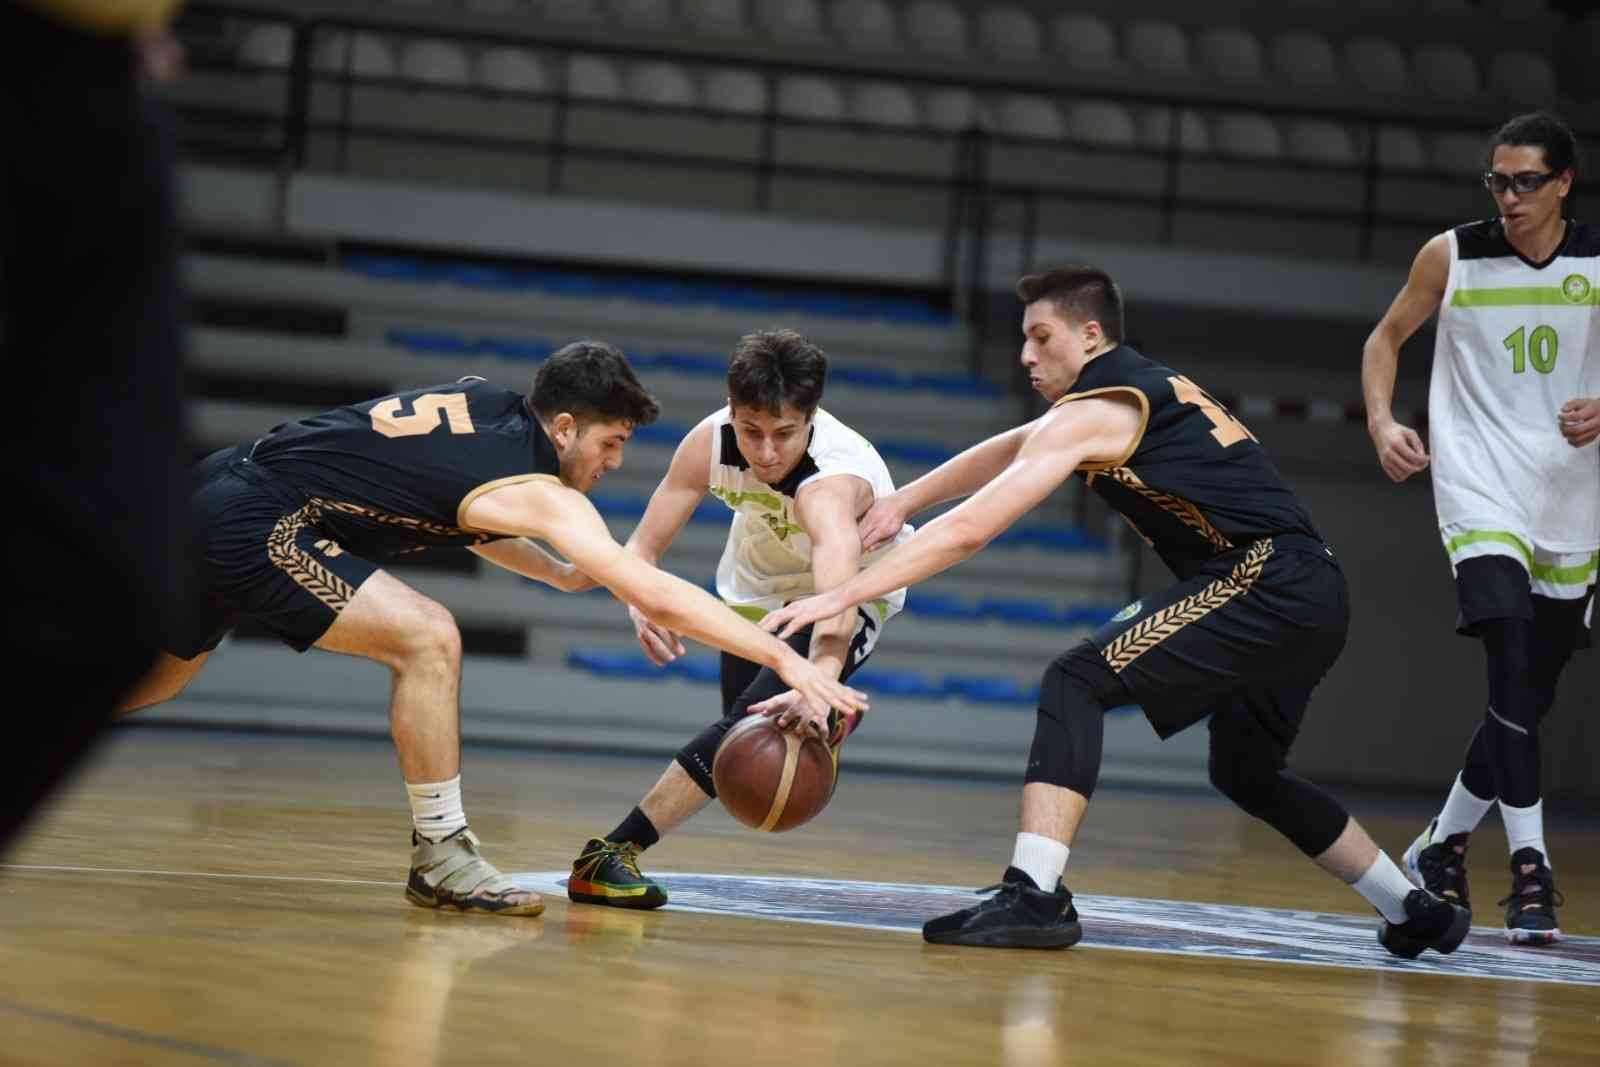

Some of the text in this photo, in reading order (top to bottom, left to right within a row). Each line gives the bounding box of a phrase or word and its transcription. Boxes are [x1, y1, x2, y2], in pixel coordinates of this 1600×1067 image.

[1503, 324, 1559, 374] 10
[368, 392, 476, 438] 5
[1166, 374, 1260, 448] 1
